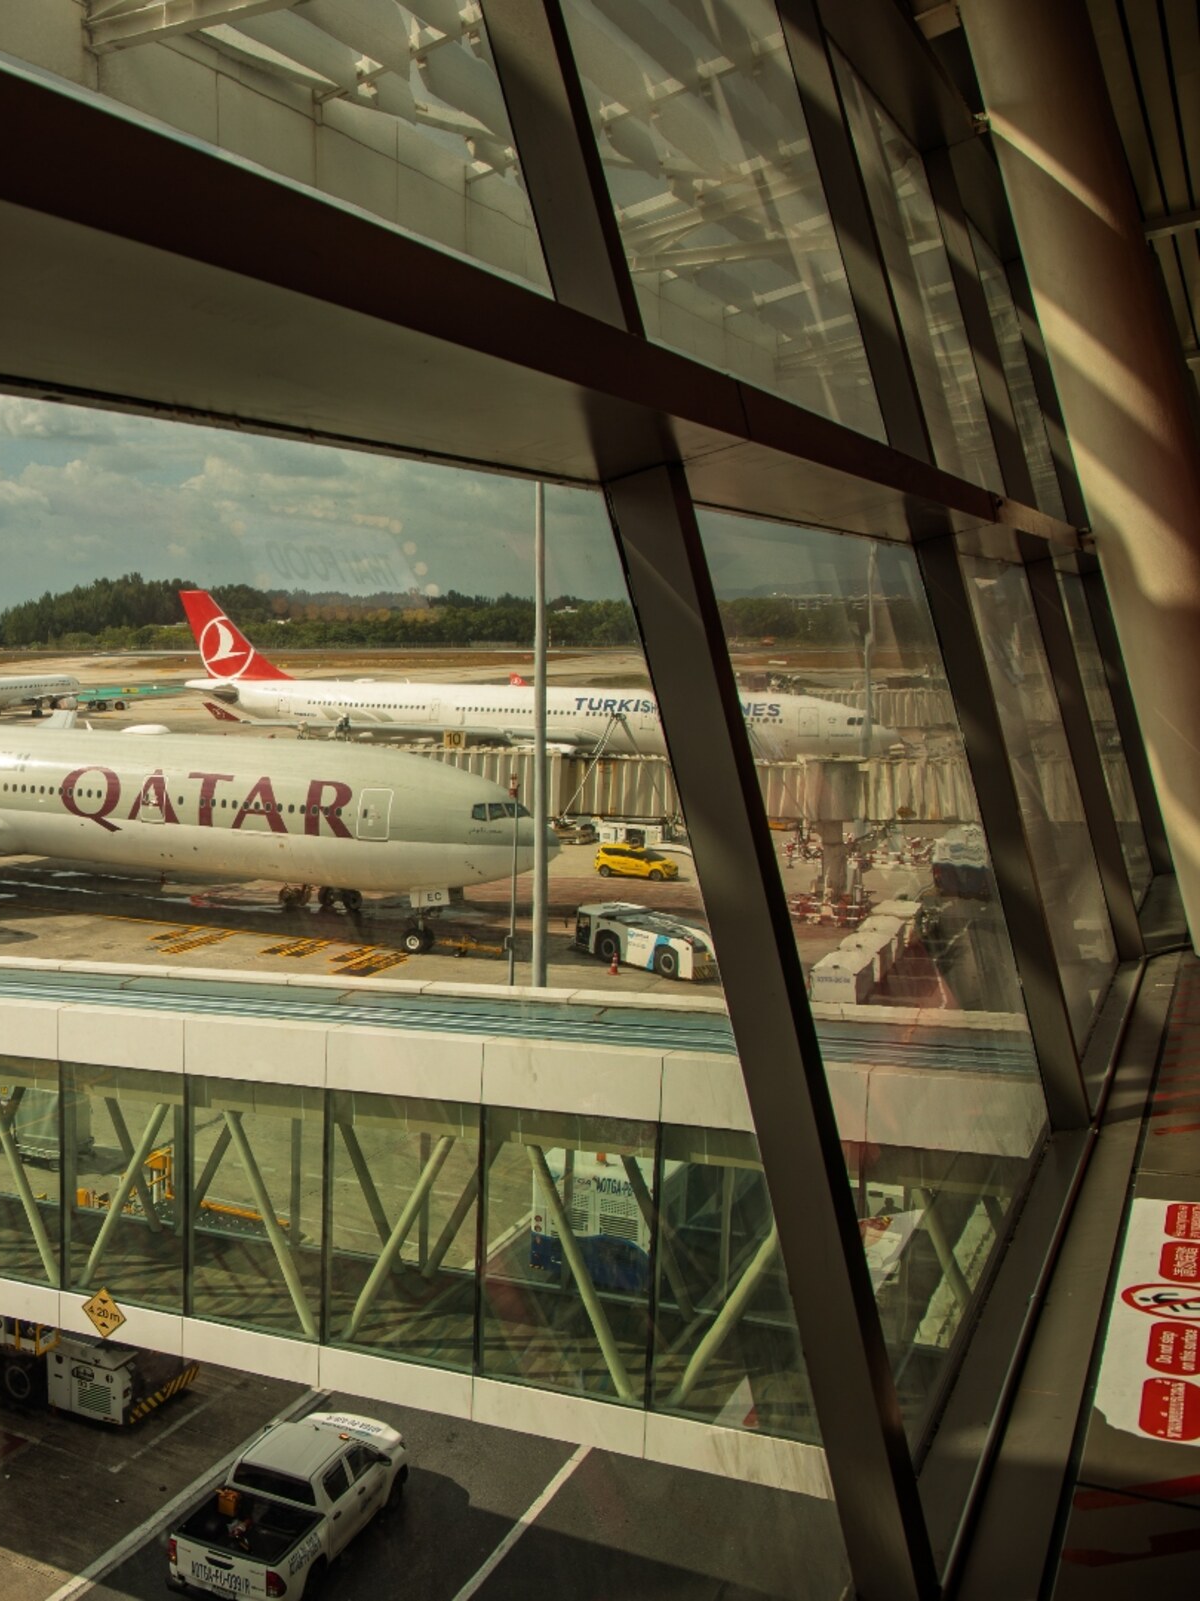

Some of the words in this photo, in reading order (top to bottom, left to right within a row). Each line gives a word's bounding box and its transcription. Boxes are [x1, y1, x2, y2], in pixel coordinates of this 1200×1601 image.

[575, 697, 658, 715] TURKISH
[447, 733, 461, 745] 10
[61, 766, 354, 839] QATAR
[427, 892, 442, 902] EC
[110, 1313, 120, 1323] m
[1160, 1330, 1178, 1344] step
[1181, 1329, 1198, 1350] surface
[1158, 1343, 1173, 1354] not
[1155, 1354, 1172, 1363] Do
[1179, 1350, 1196, 1362] this
[1182, 1362, 1195, 1371] on
